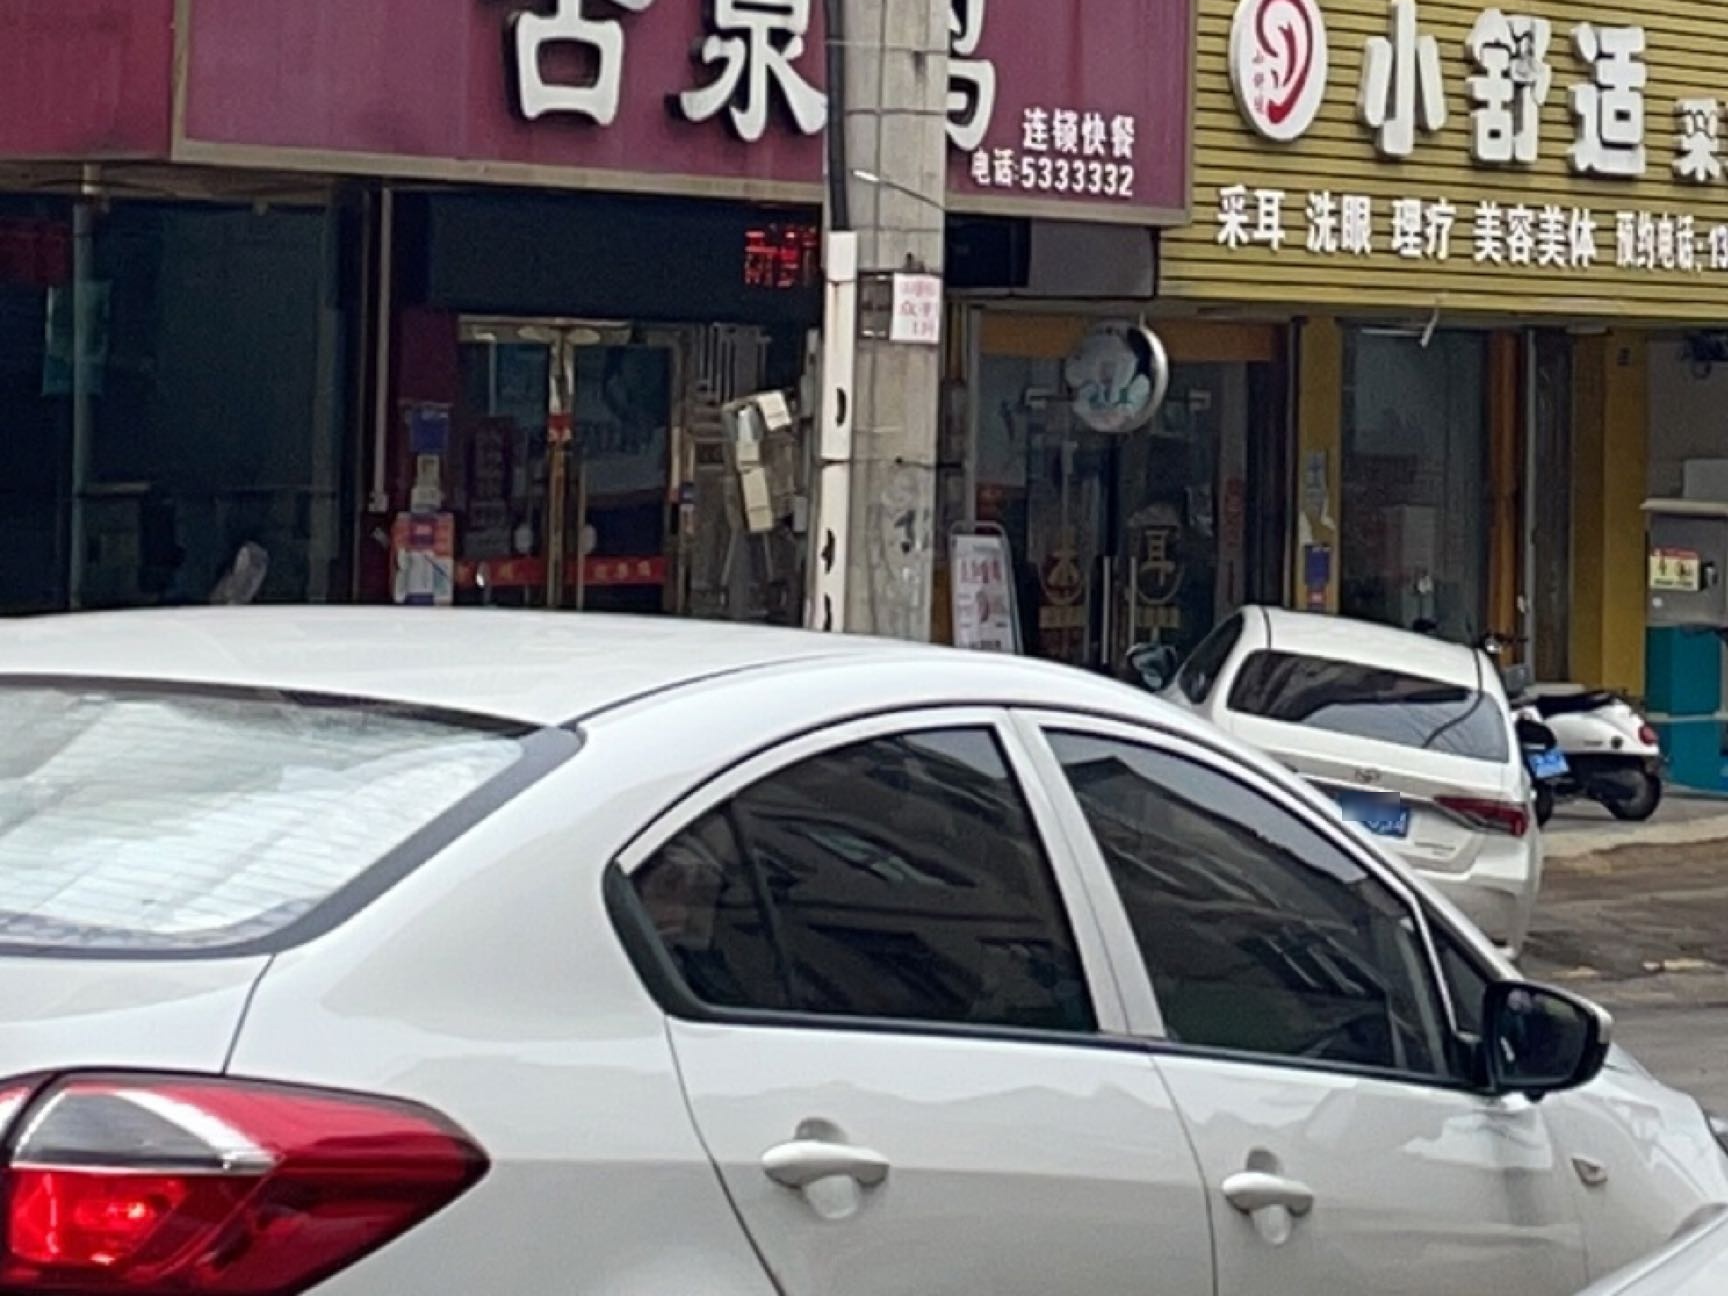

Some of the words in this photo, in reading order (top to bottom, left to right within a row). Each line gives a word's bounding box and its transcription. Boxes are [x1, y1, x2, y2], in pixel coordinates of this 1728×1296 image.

[1022, 106, 1135, 159] 连锁快餐
[1217, 184, 1286, 252] 采耳
[1305, 189, 1372, 256] 洗眼
[1391, 195, 1457, 261] 理疗
[1472, 200, 1598, 269] 美容美体
